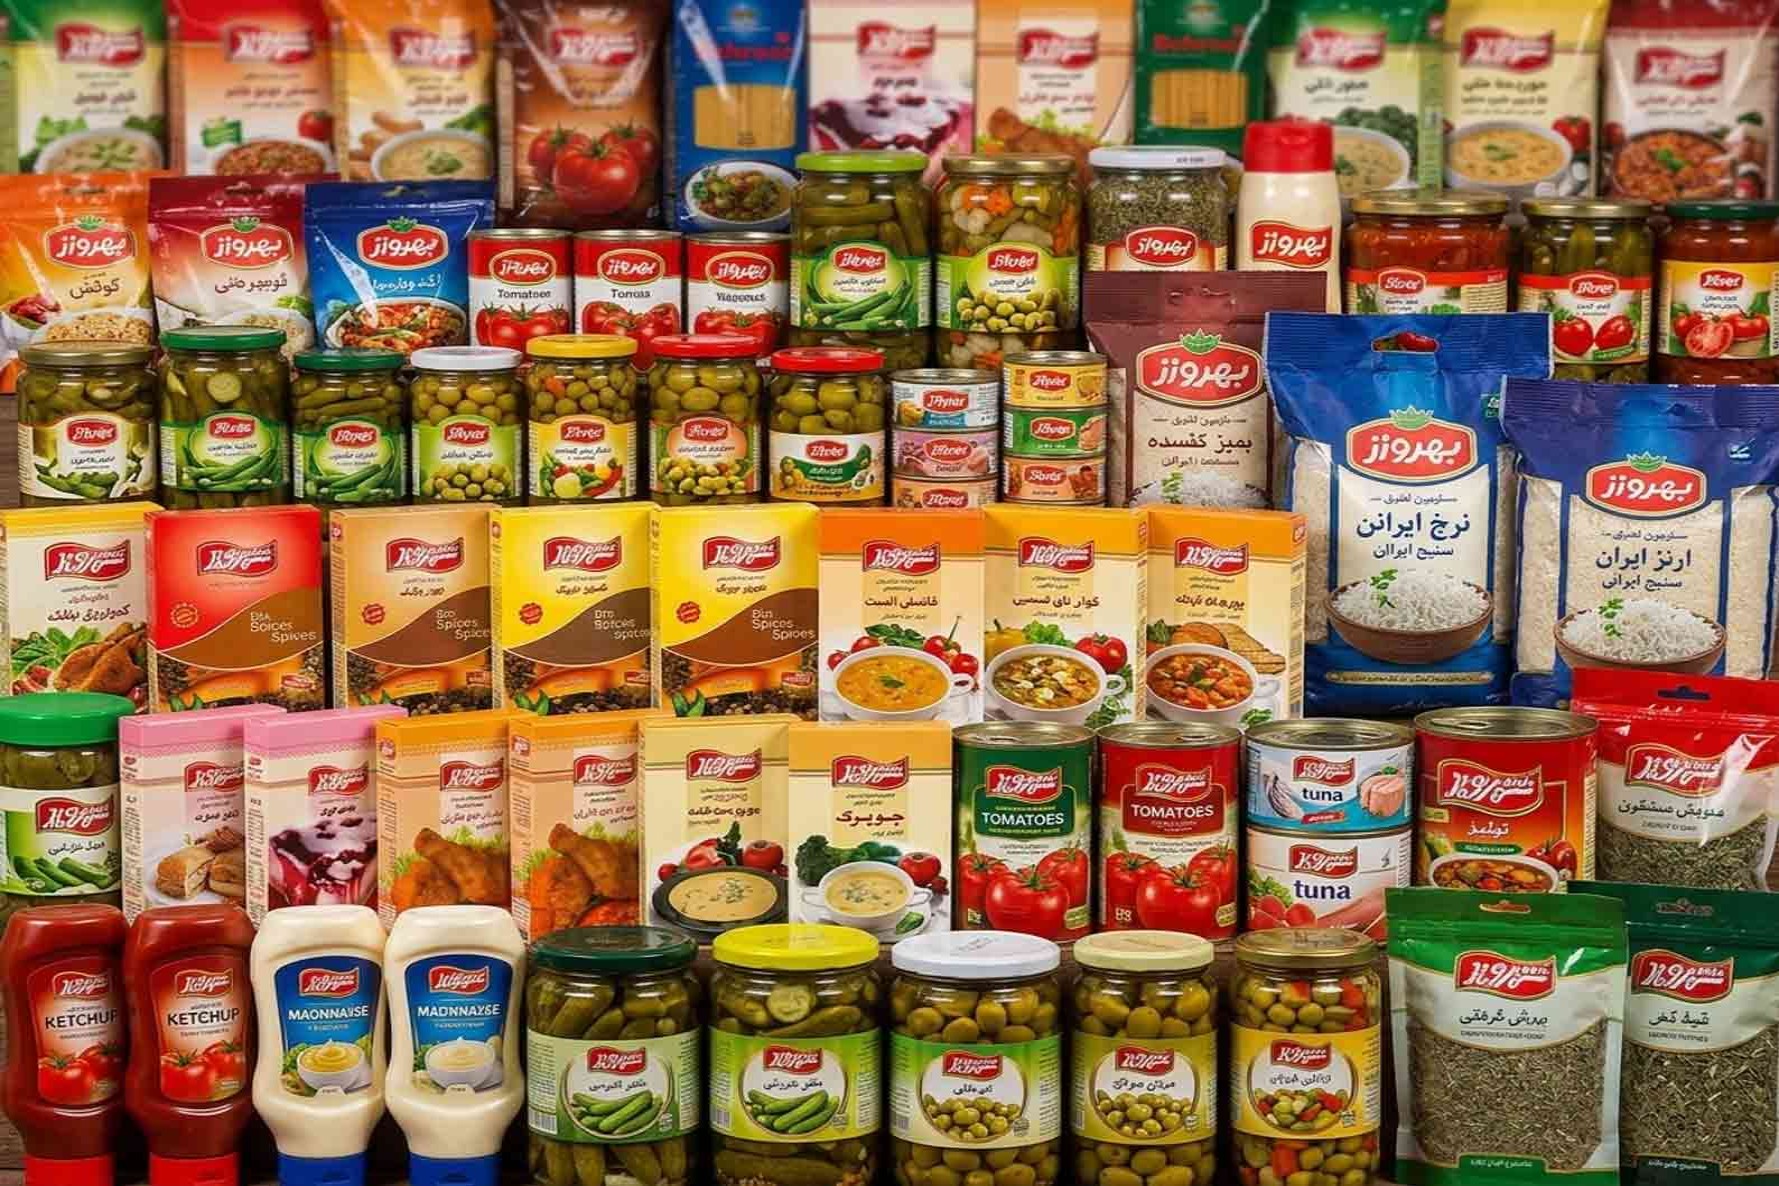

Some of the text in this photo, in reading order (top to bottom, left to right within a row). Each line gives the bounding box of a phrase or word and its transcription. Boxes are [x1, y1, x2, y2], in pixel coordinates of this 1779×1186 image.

[1302, 787, 1343, 802] tuna
[981, 811, 1065, 826] TOMATOES
[1131, 804, 1215, 818] TOMATOES
[1293, 880, 1351, 900] tuna
[45, 1010, 118, 1029] KETCHUP
[167, 1007, 240, 1026] KETCHUP
